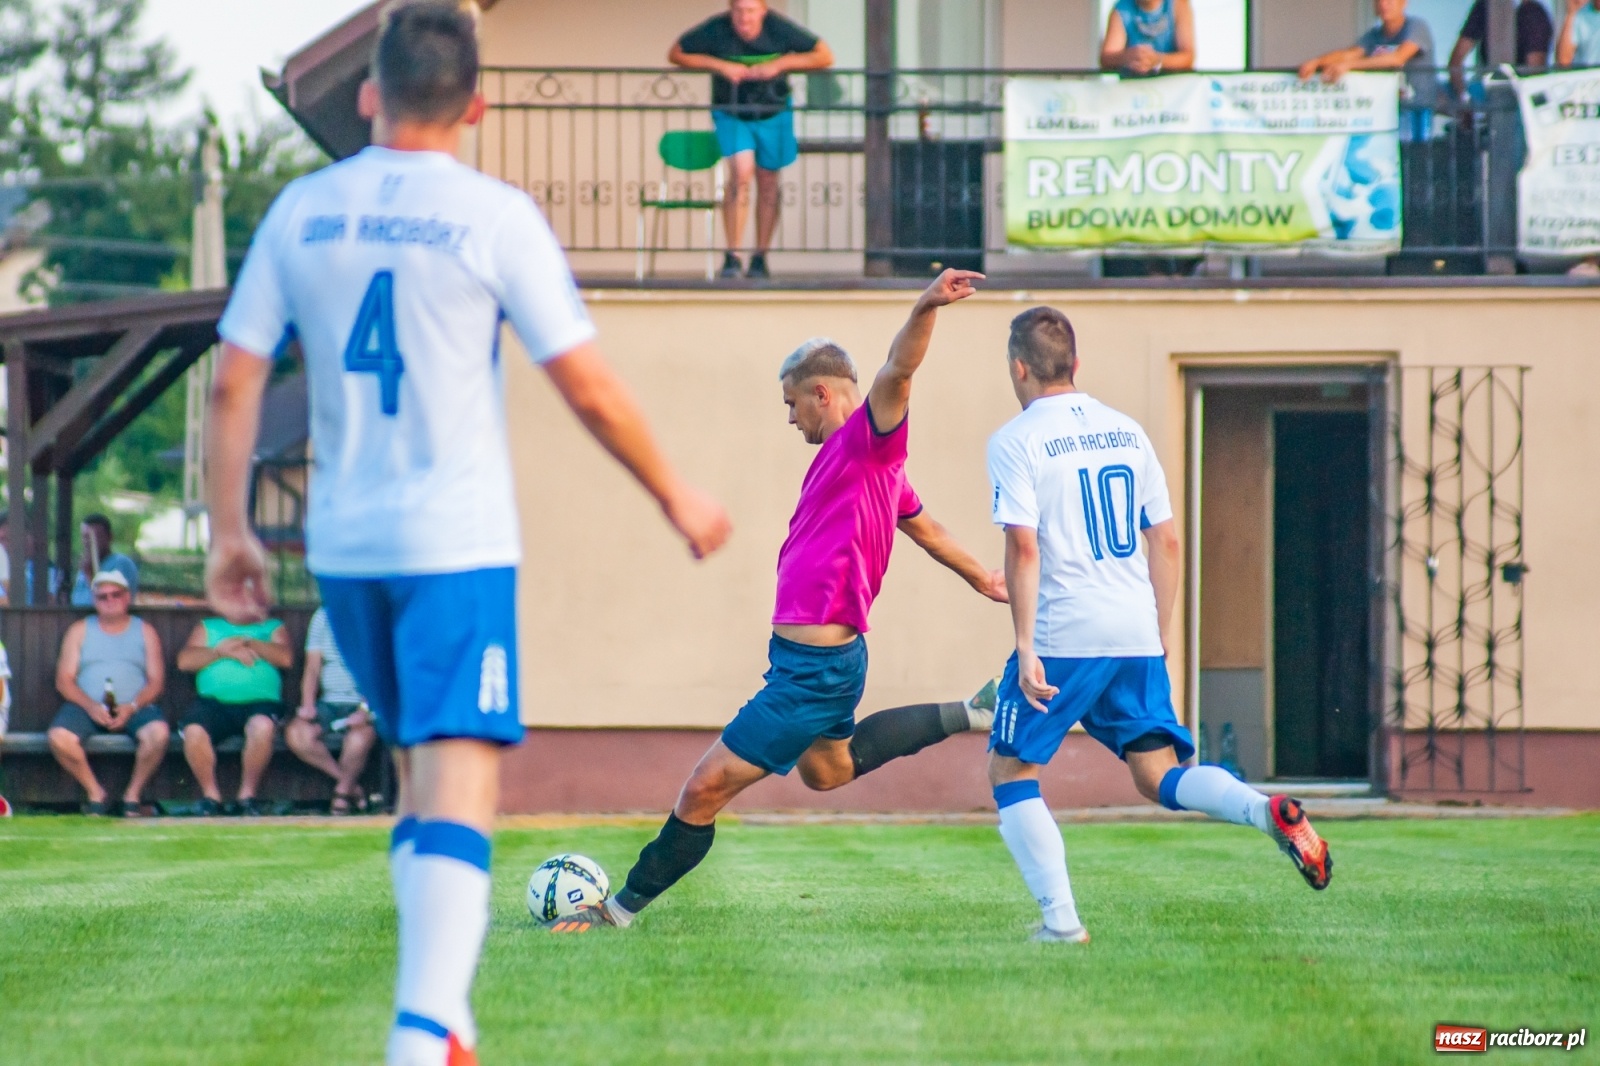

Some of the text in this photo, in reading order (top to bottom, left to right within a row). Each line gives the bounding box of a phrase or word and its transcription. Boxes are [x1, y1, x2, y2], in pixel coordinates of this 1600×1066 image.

[1027, 150, 1302, 199] REMONTY
[1028, 202, 1295, 231] BUDOWA DOMÓW
[344, 267, 405, 416] 4
[1045, 427, 1140, 457] UNIA RACIBÓRZ
[1078, 464, 1136, 561] 10
